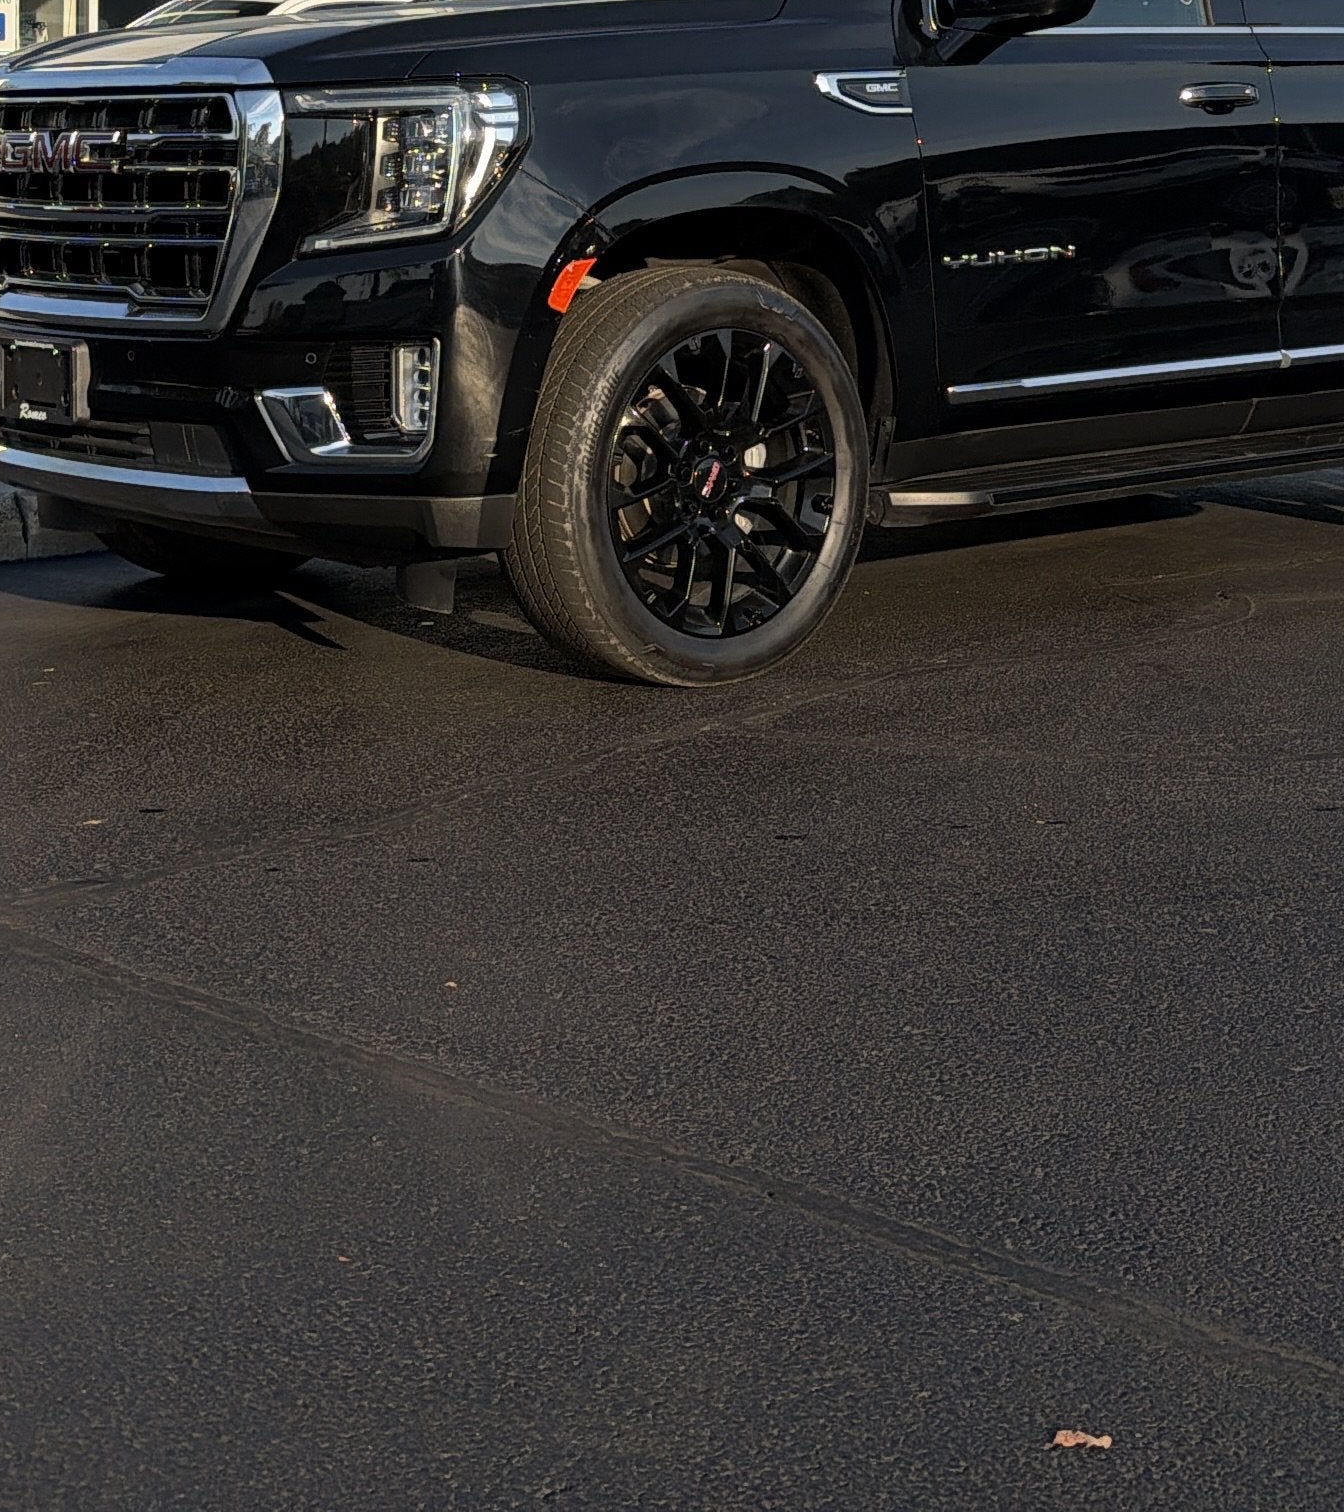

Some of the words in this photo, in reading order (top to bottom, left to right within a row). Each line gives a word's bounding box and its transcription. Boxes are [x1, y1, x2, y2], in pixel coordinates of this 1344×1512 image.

[865, 82, 900, 93] GMC
[1, 131, 122, 173] GMC
[943, 244, 1076, 269] YUKON
[19, 402, 47, 421] Romeo
